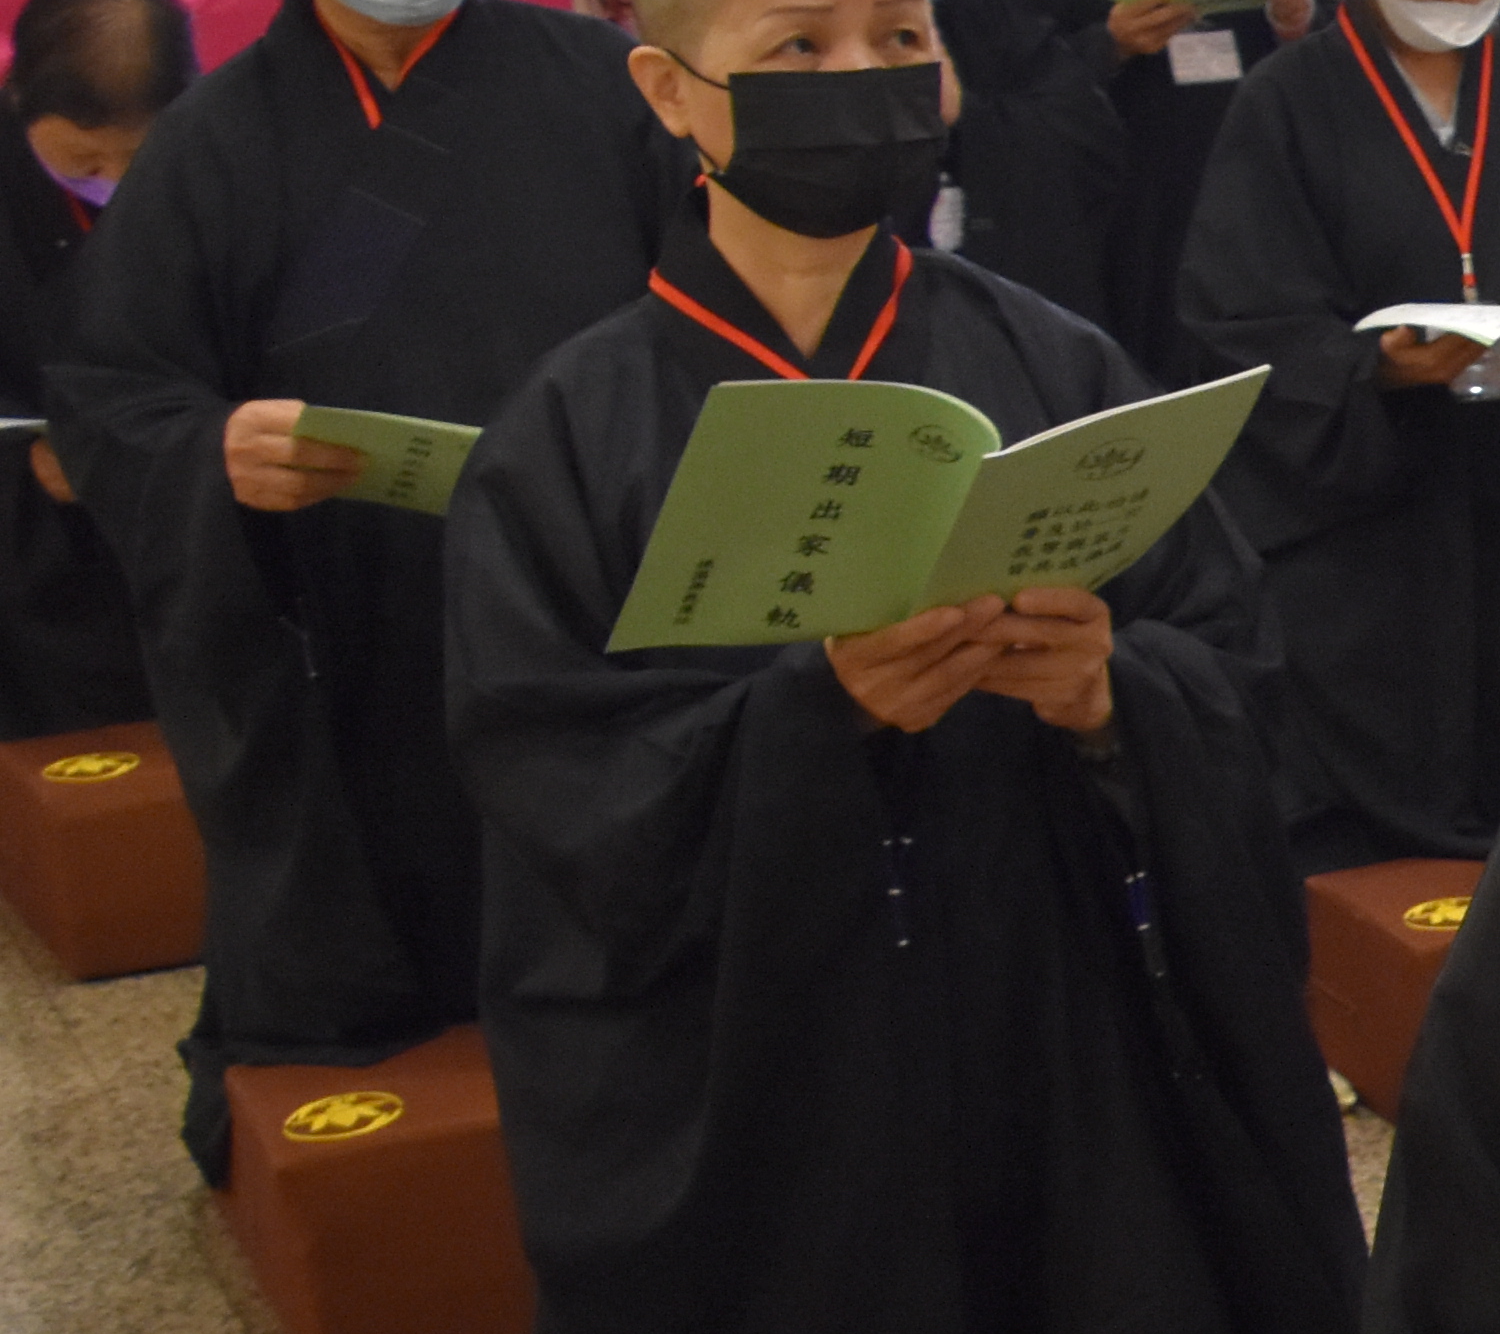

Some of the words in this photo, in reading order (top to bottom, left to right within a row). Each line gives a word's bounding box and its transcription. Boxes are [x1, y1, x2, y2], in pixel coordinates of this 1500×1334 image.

[764, 428, 874, 629] 短期出家儀軌
